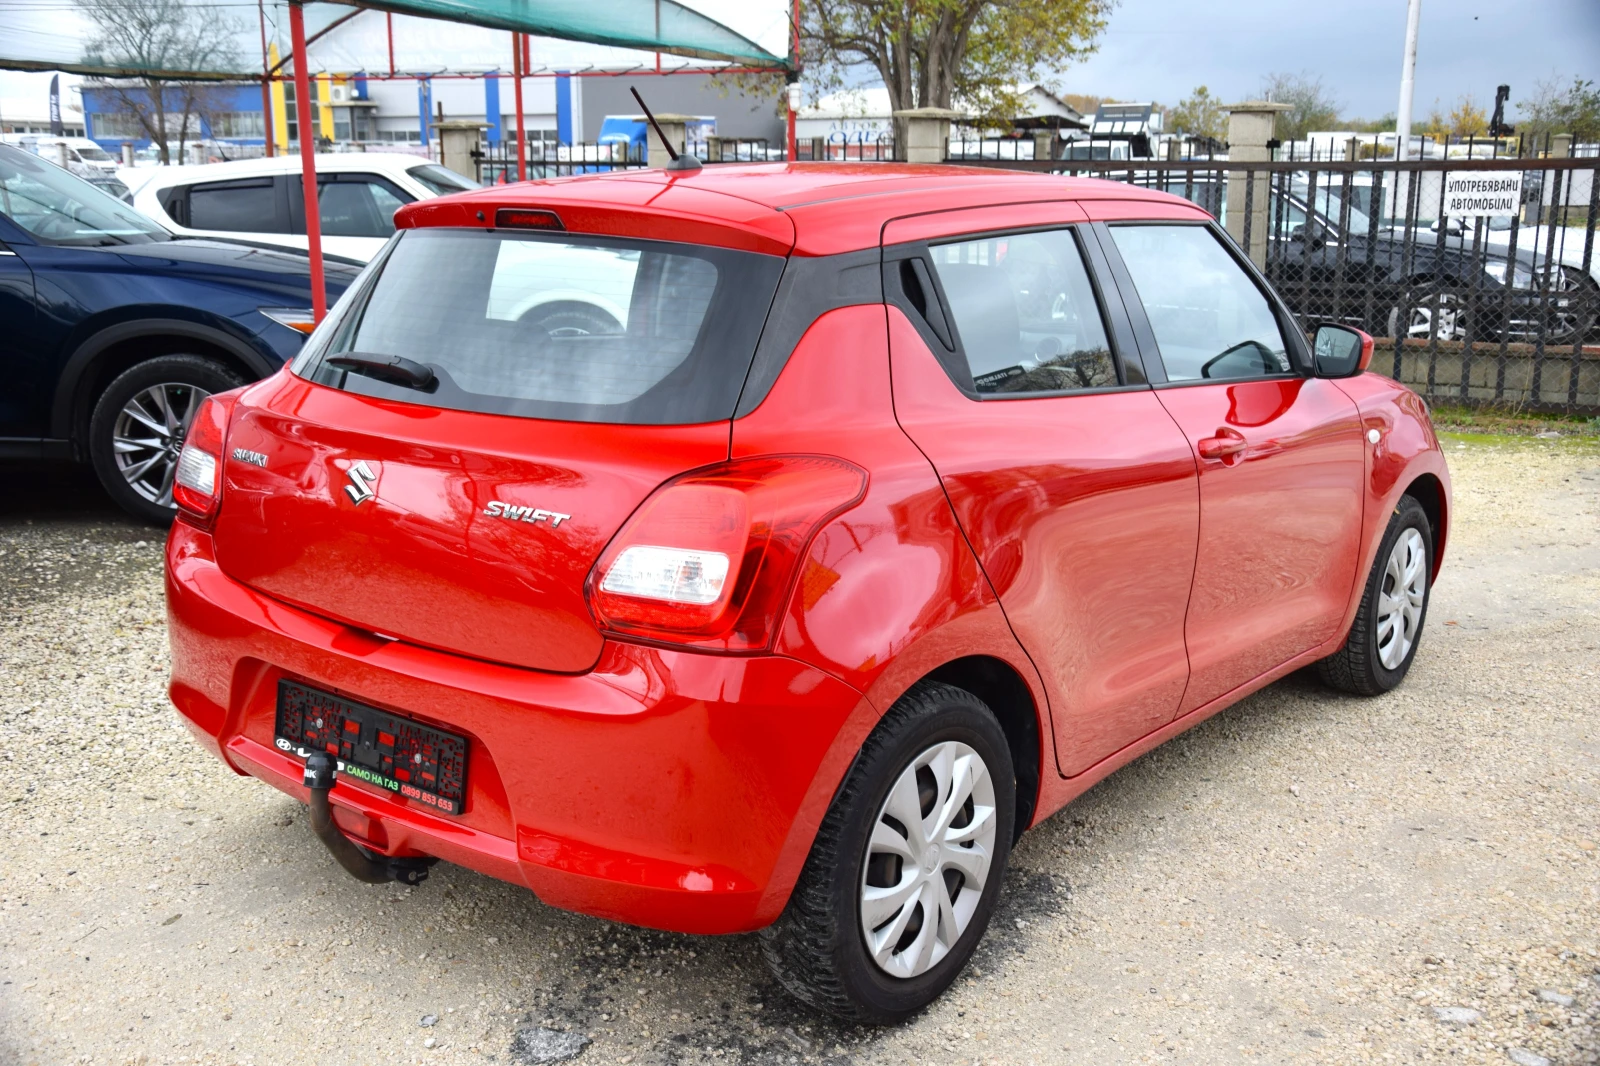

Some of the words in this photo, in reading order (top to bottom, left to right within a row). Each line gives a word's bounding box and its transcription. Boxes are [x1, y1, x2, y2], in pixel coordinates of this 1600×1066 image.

[1448, 179, 1519, 193] УПОТРЕБЯВАНИ
[1450, 198, 1513, 210] АВТОМОБИЛИ
[232, 447, 268, 467] SUZUKI
[483, 500, 572, 528] SWIFT
[347, 765, 371, 780] САМО
[371, 773, 383, 786] НА
[384, 779, 399, 791] ГАЗ
[401, 785, 421, 799] 0899
[422, 792, 436, 805] 853
[438, 798, 453, 811] 653
